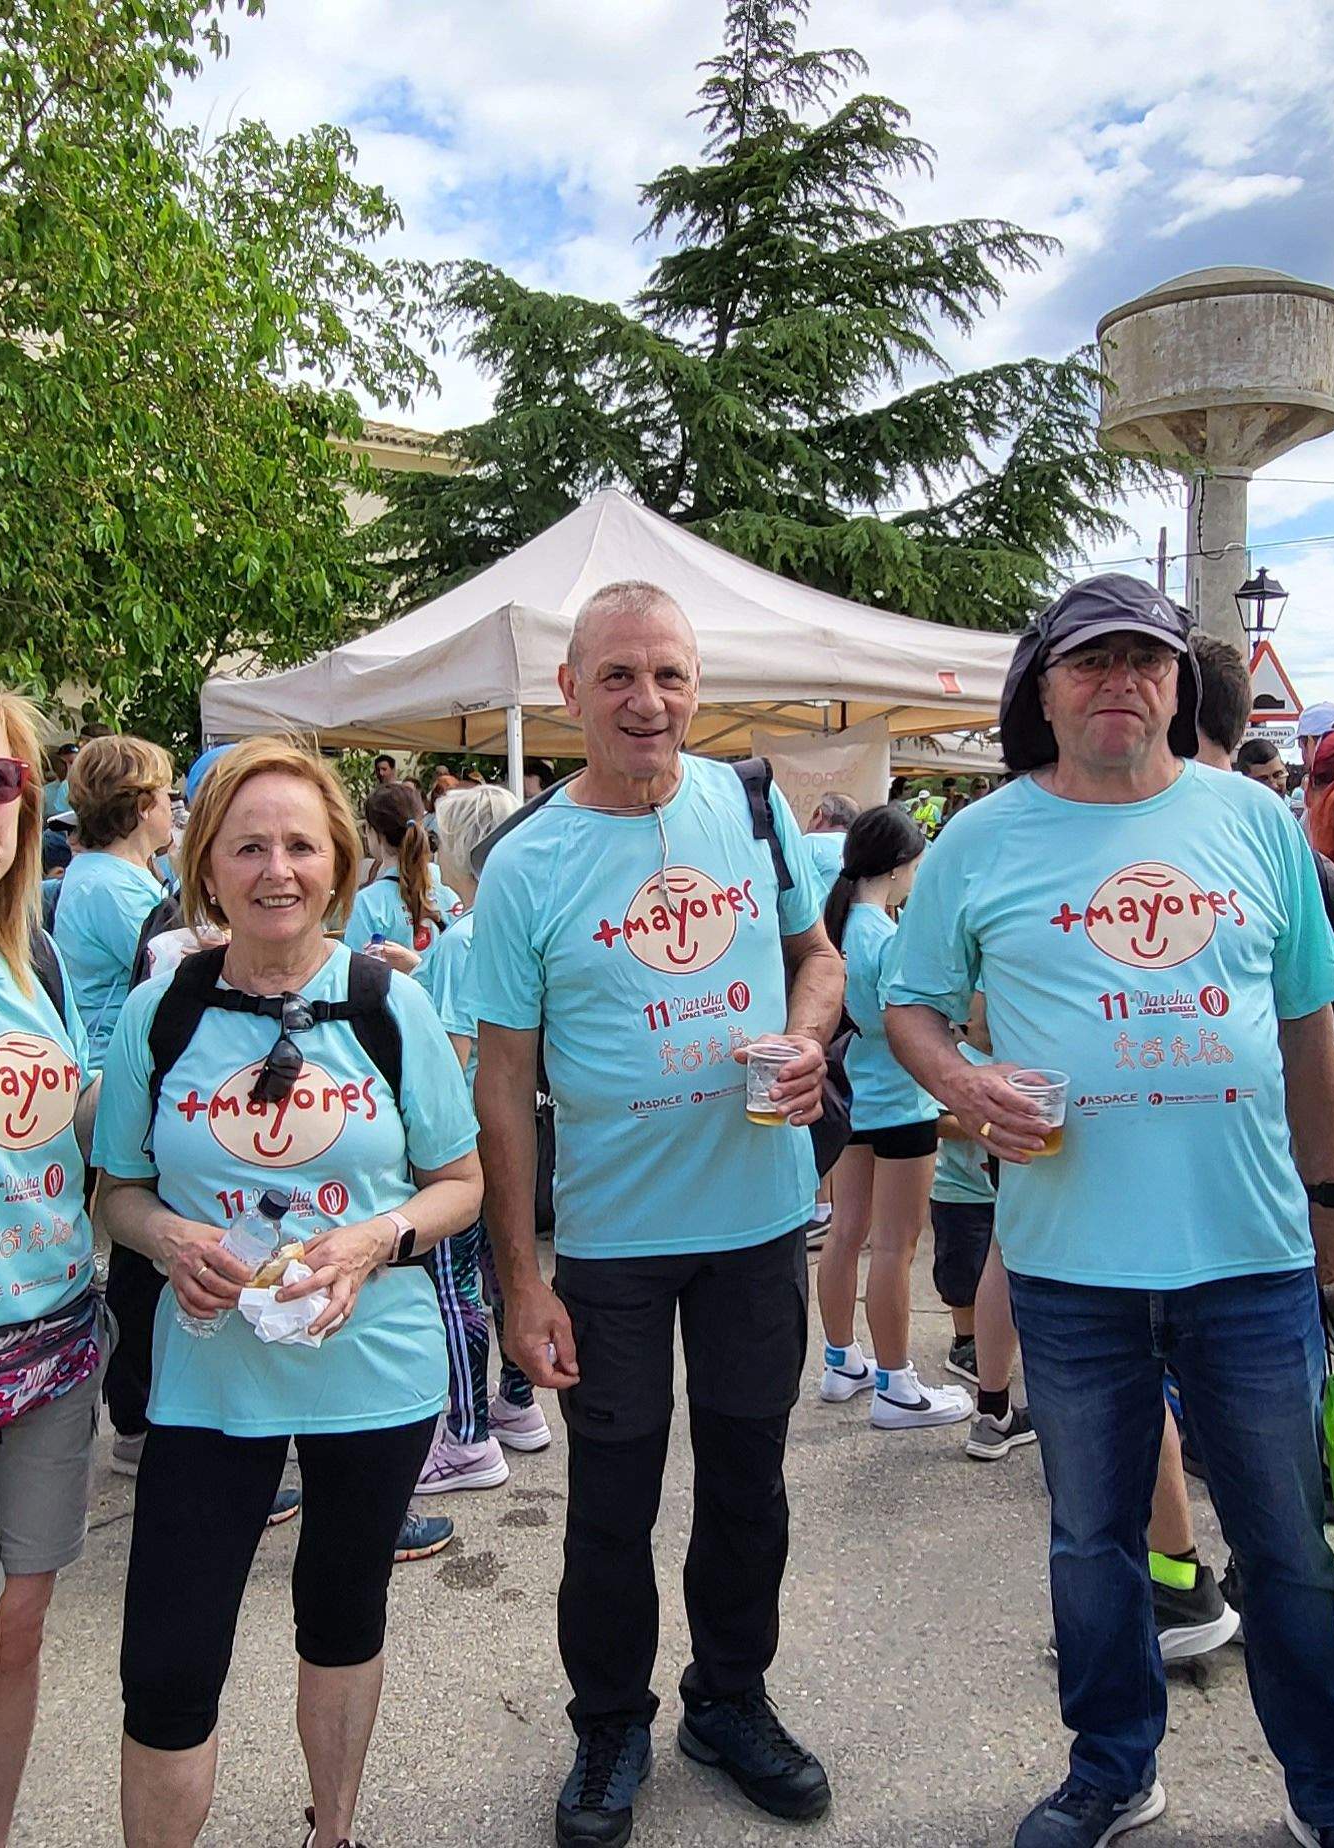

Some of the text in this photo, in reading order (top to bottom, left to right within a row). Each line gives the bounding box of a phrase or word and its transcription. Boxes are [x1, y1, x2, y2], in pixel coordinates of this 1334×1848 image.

[593, 879, 759, 948] +mayores
[1050, 889, 1244, 942] +mayores
[177, 1076, 378, 1139] +mayores
